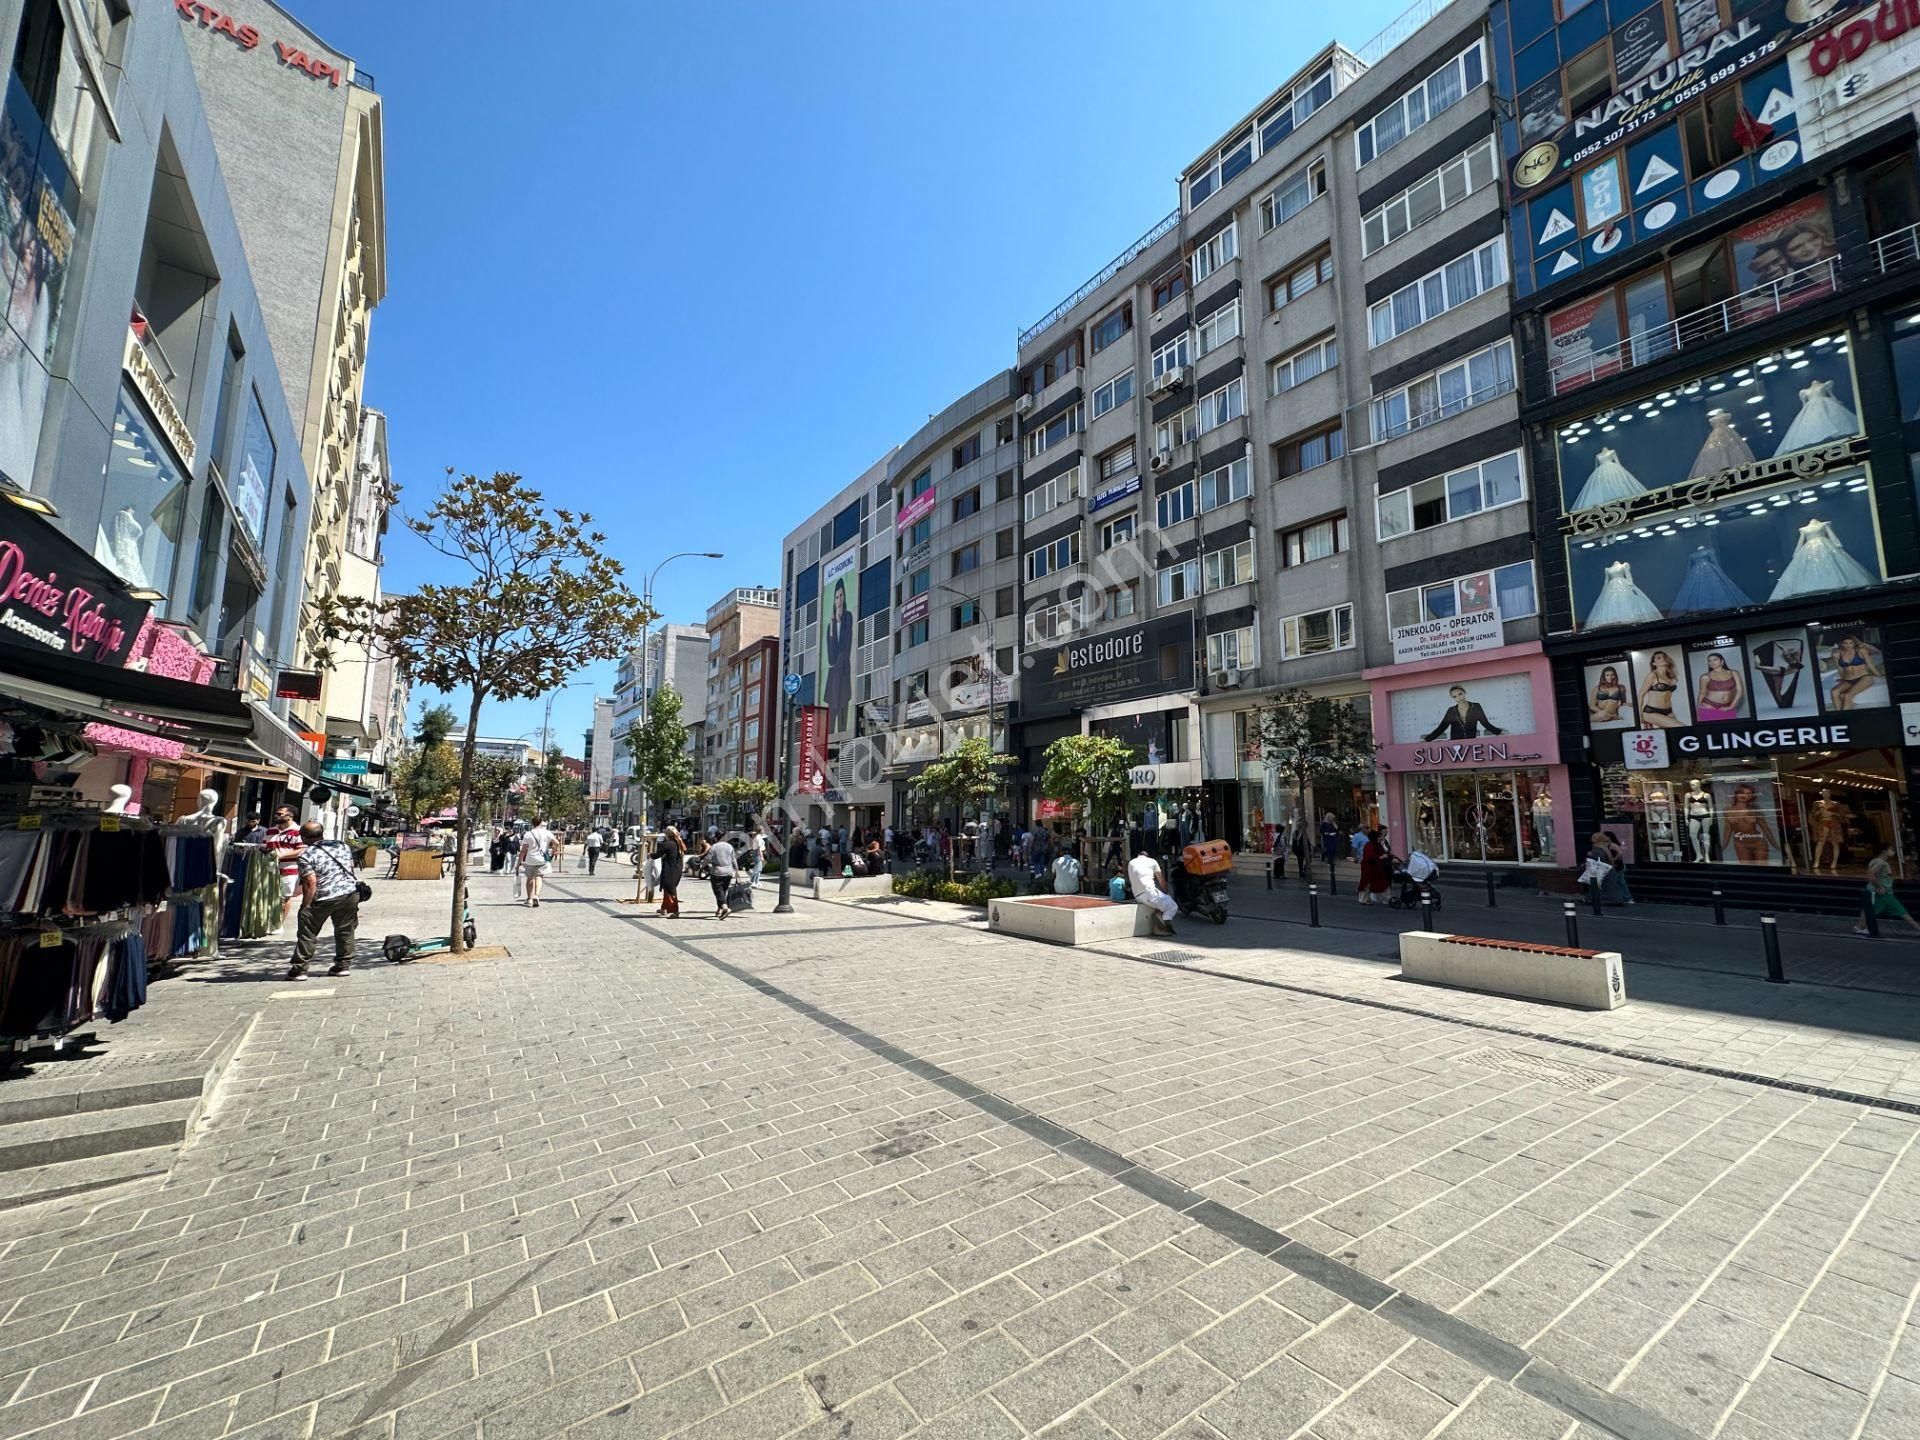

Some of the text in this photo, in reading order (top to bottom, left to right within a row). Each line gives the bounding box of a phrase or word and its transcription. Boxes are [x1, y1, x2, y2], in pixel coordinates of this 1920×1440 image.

[276, 38, 340, 87] YAPI
[1575, 16, 1761, 138] NATURAL
[1573, 40, 1777, 163] 0552 307 31 73 0553 699 33 79
[0, 608, 66, 650] Accessories
[1398, 622, 1441, 639] JİNEKOLOG
[1449, 610, 1495, 629] OPERATÖR
[1451, 628, 1470, 638] AKSOY
[1070, 632, 1144, 669] estedore
[1414, 743, 1508, 765] SUWEN
[1679, 725, 1850, 752] G LINGERIE
